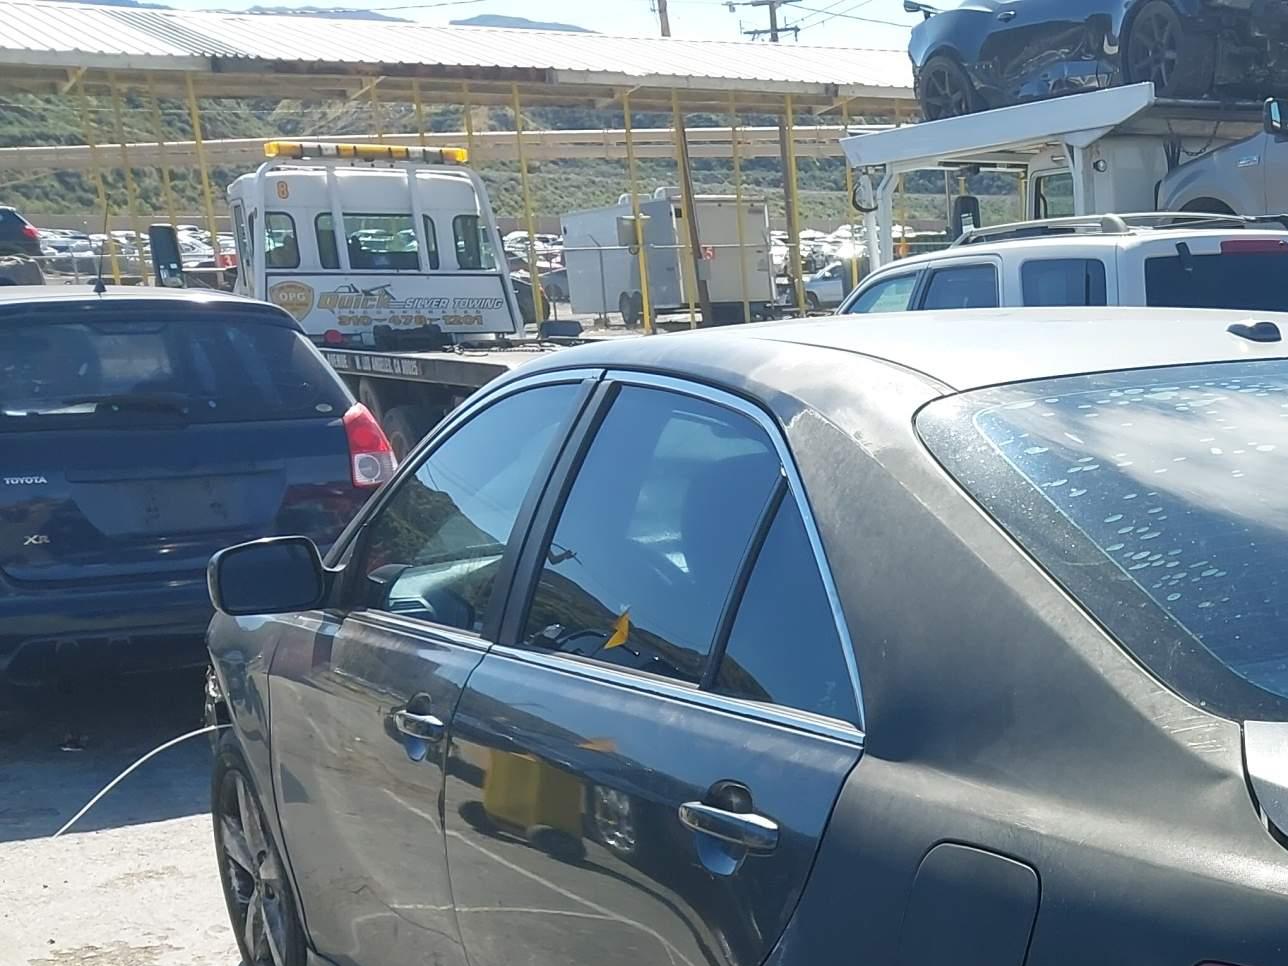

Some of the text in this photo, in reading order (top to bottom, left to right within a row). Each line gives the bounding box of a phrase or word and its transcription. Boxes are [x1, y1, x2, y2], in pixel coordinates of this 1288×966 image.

[277, 180, 289, 199] 8
[279, 292, 306, 302] OPG
[404, 297, 450, 310] SILVER
[452, 297, 503, 310] TOWING
[3, 476, 49, 485] TOYOTA
[23, 534, 50, 546] XR
